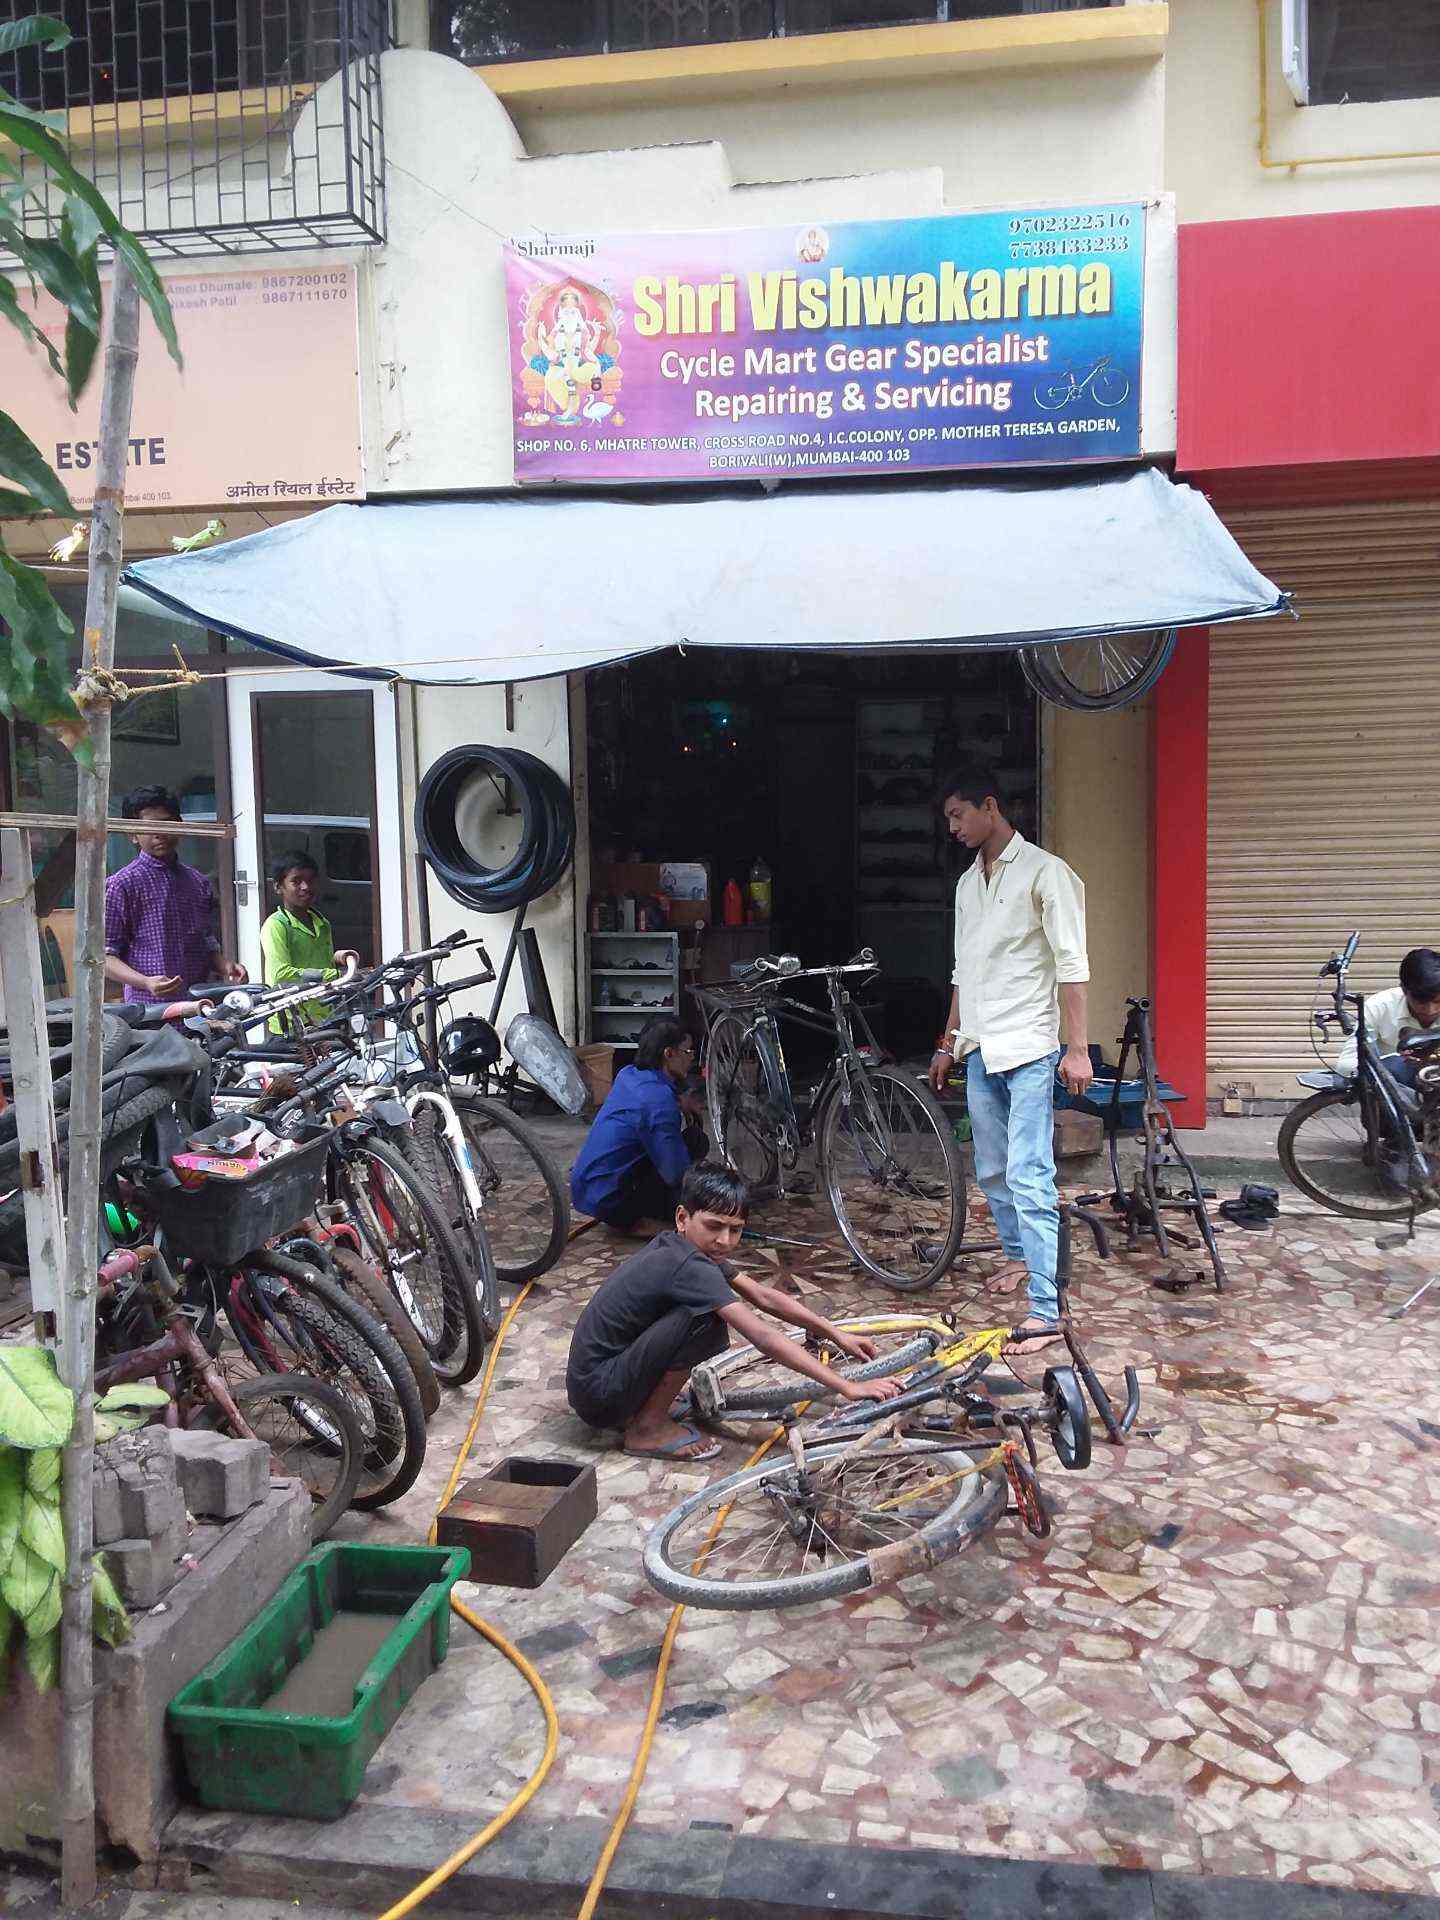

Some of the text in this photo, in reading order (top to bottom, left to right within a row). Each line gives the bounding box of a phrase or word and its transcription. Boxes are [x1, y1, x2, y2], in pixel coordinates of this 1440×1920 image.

[1010, 212, 1130, 234] 9702322516
[517, 239, 595, 258] Sharmaji
[632, 262, 1111, 336] Shri Vishwakarma
[659, 332, 1050, 384] Cycle Mart Gear Specialist
[694, 376, 1014, 423] Repairing & Servicing
[516, 418, 1122, 453] SHOP NO. 6, MHATRE TOWER, CROSS ROAD NO.4, I.C.COLONY, OPP. MOTHER TERESA GARDEN,
[56, 437, 165, 469] ESTE
[887, 449, 910, 462] 103
[226, 481, 270, 497] अमोल
[273, 480, 313, 495] रियल
